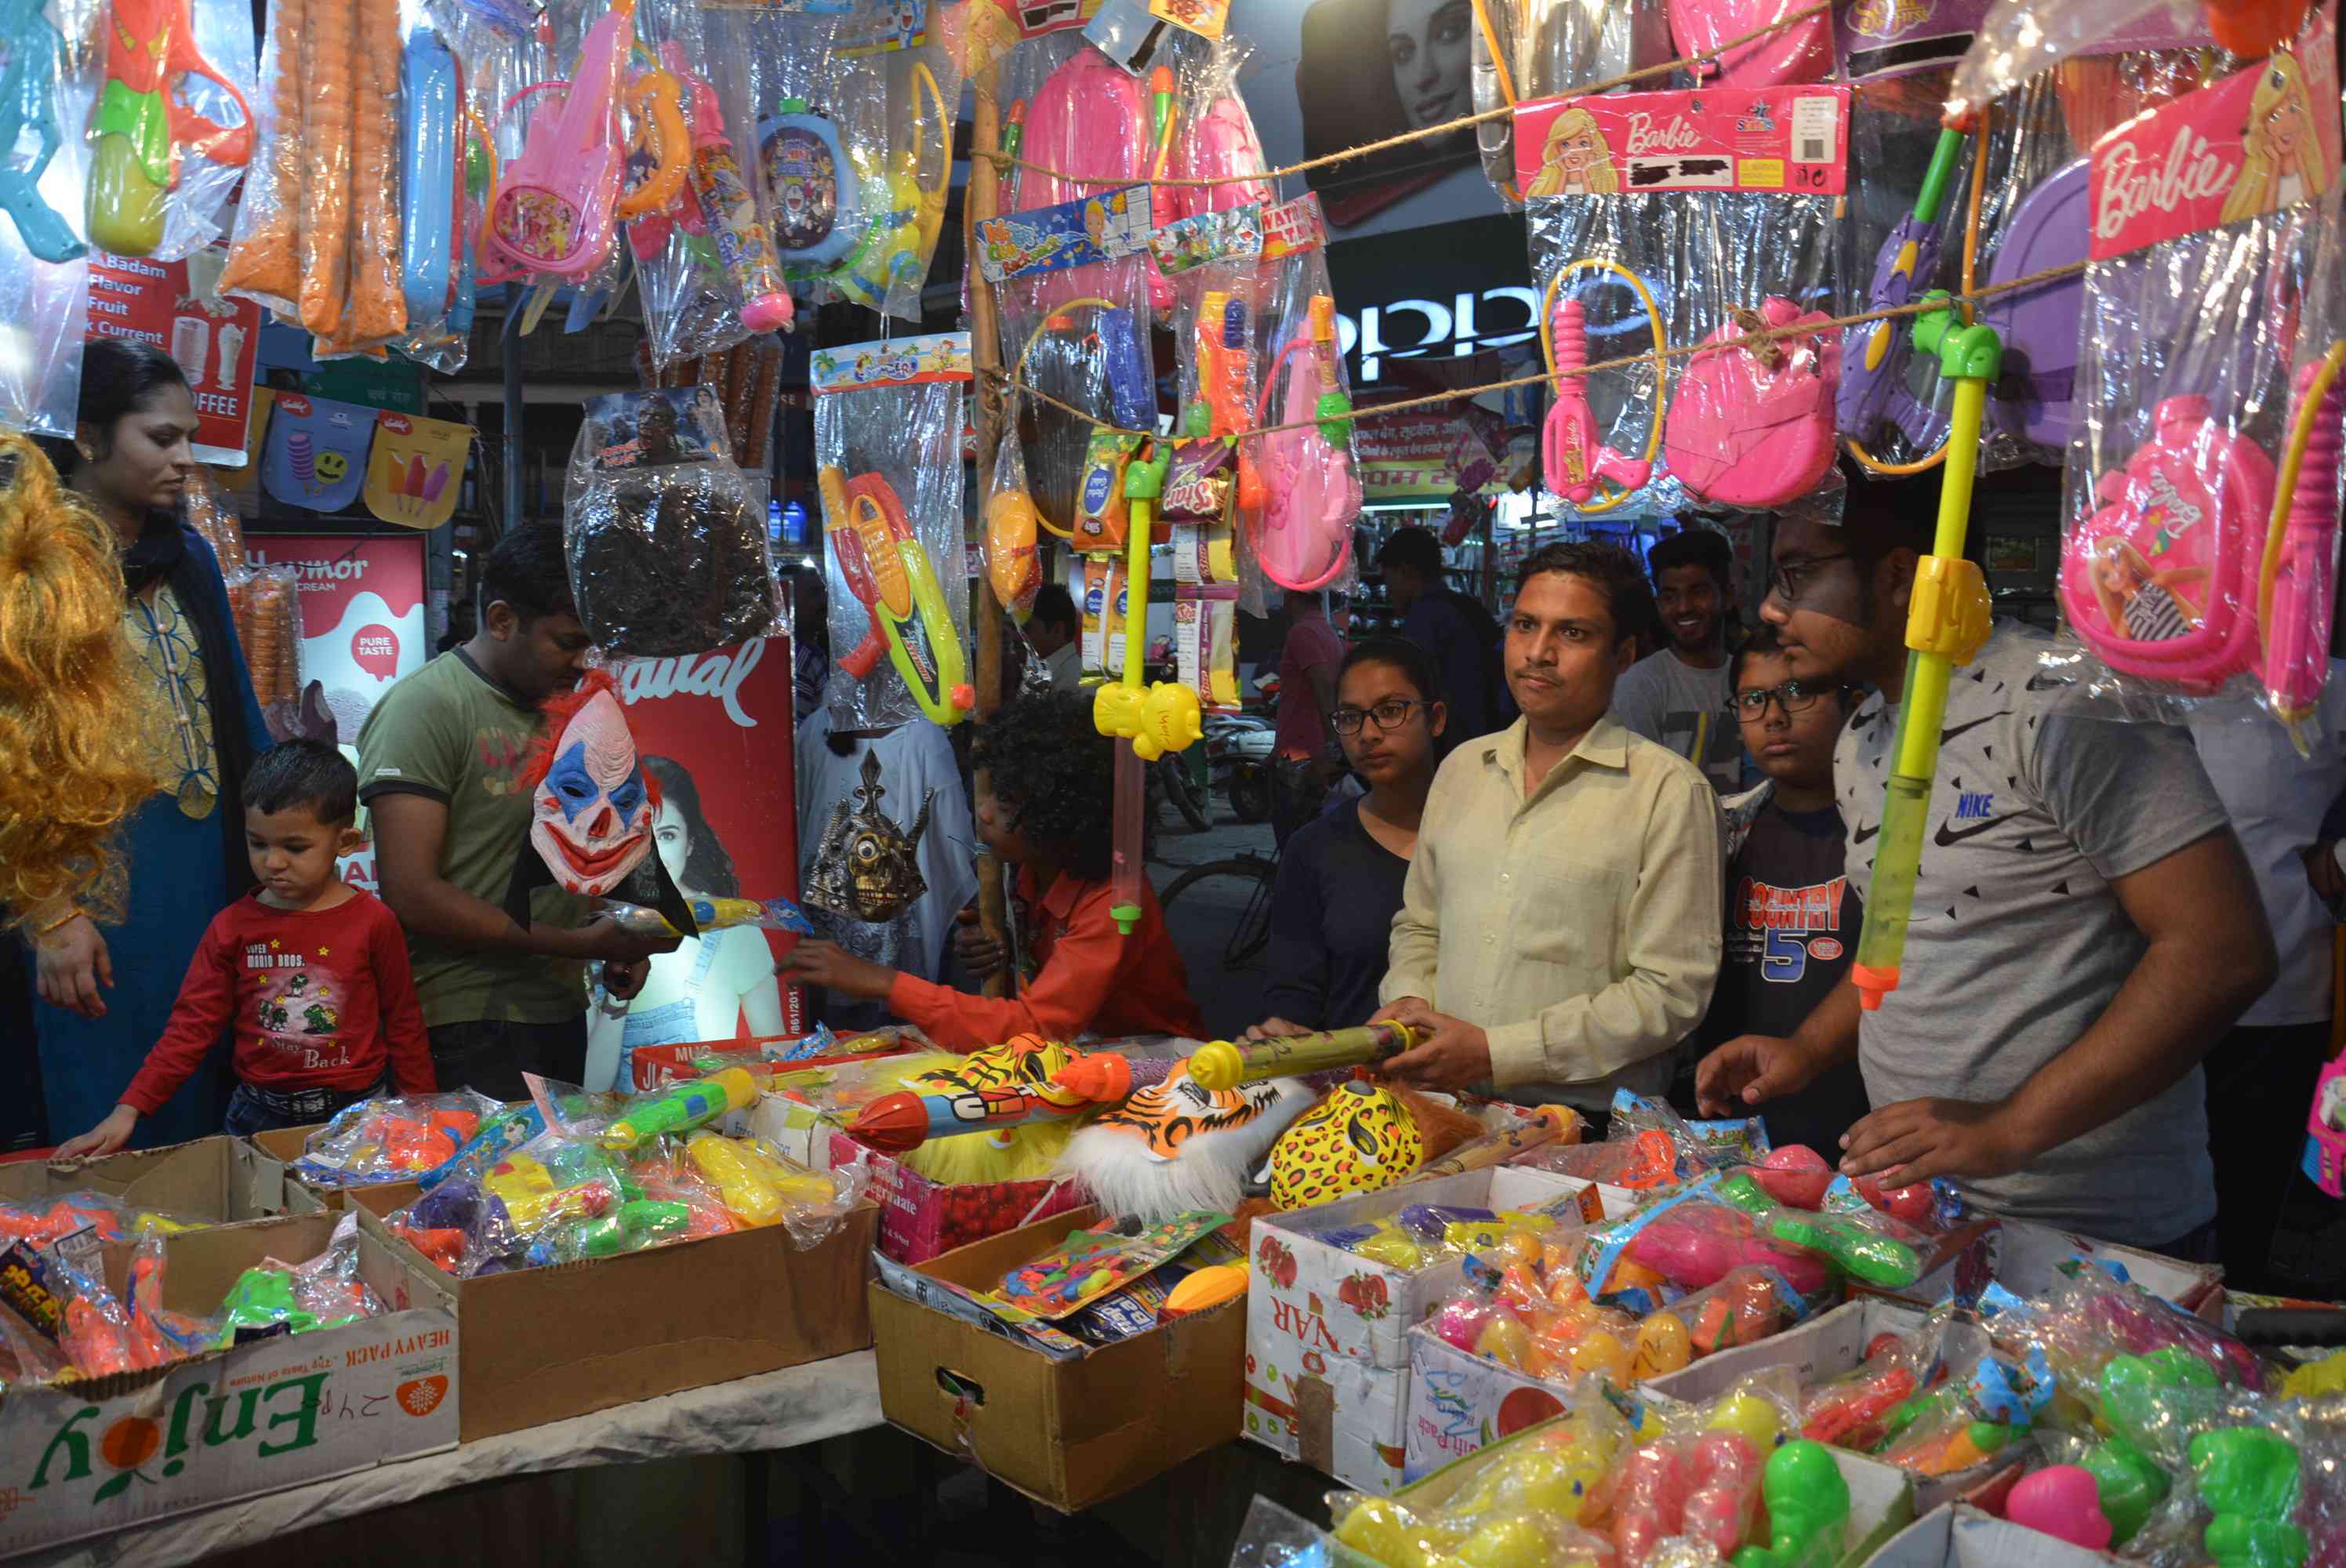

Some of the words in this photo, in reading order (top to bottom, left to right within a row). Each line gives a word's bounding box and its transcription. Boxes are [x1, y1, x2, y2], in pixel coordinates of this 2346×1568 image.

[1626, 112, 1702, 154] Barbie
[2097, 125, 2234, 239] Barbie
[106, 255, 166, 279] Badam
[89, 274, 143, 296] Flavor
[89, 296, 130, 316] Fruit
[98, 320, 165, 345] Current
[196, 393, 238, 416] FFEE
[1164, 479, 1215, 514] Star
[358, 647, 394, 655] TASTE
[359, 637, 390, 646] PURE
[1956, 791, 1995, 818] NIKE
[1734, 875, 1848, 931] COUNTRY
[245, 943, 267, 954] SUPER
[1761, 928, 1807, 983] 5
[247, 954, 274, 969] MARIO
[278, 953, 306, 967] BROS.
[271, 1037, 302, 1054] Stay
[303, 1045, 351, 1069] Back
[1269, 1295, 1342, 1354] NAR
[345, 1341, 391, 1368] PACK
[394, 1330, 450, 1357] HEAVY
[229, 1374, 266, 1386] Nature
